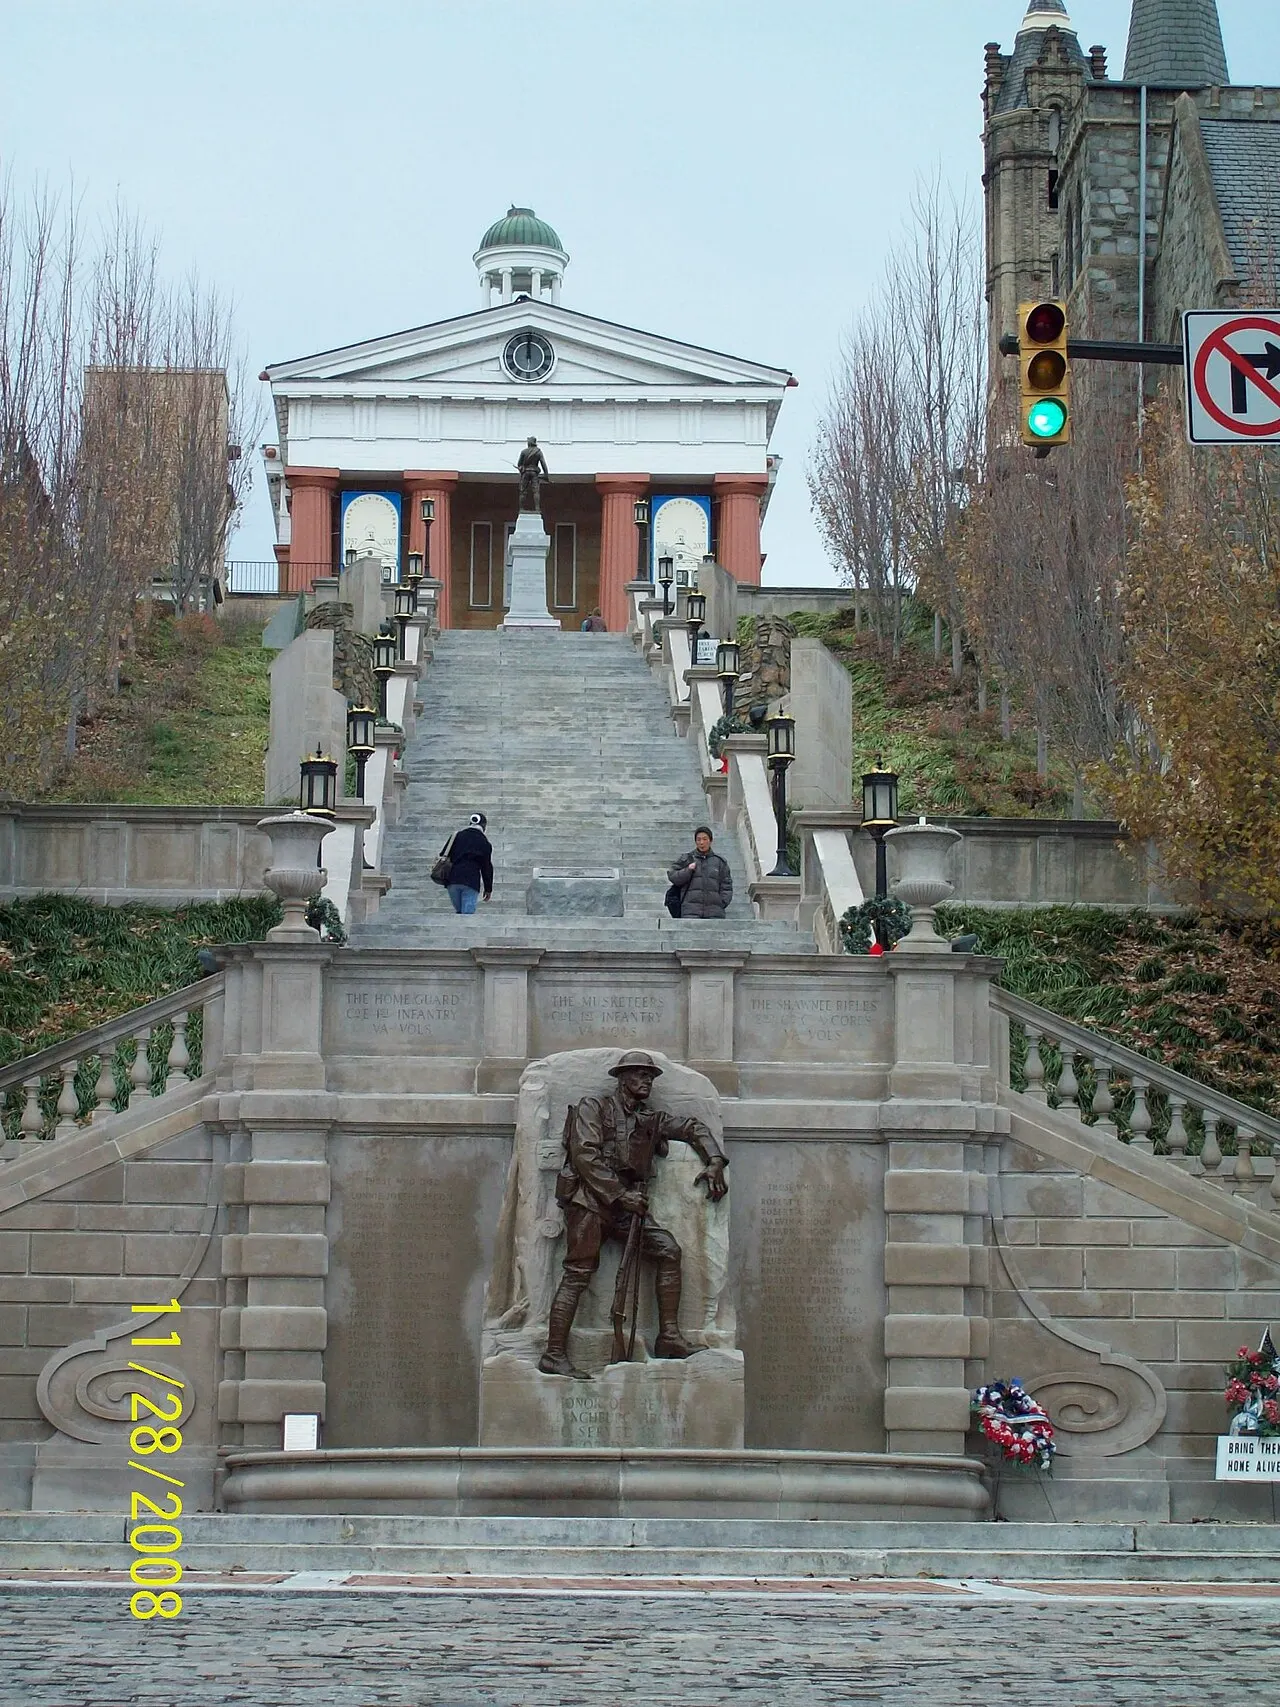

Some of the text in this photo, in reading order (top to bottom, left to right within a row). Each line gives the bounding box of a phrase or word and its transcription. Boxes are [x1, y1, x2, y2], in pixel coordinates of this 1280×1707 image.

[382, 537, 397, 546] 2007
[345, 993, 461, 1006] THE HOME GUARD
[551, 995, 665, 1008] THE MUSKETEERS
[751, 999, 881, 1012] THE SHAWNEE RIFLES
[397, 1008, 457, 1021] INFANTRY
[601, 1010, 663, 1023] INFANTRY
[399, 1023, 433, 1036] VOLS
[808, 1029, 843, 1041] VOLS
[1228, 1442, 1254, 1454] BRING
[1227, 1460, 1280, 1473] HOME ALIVE
